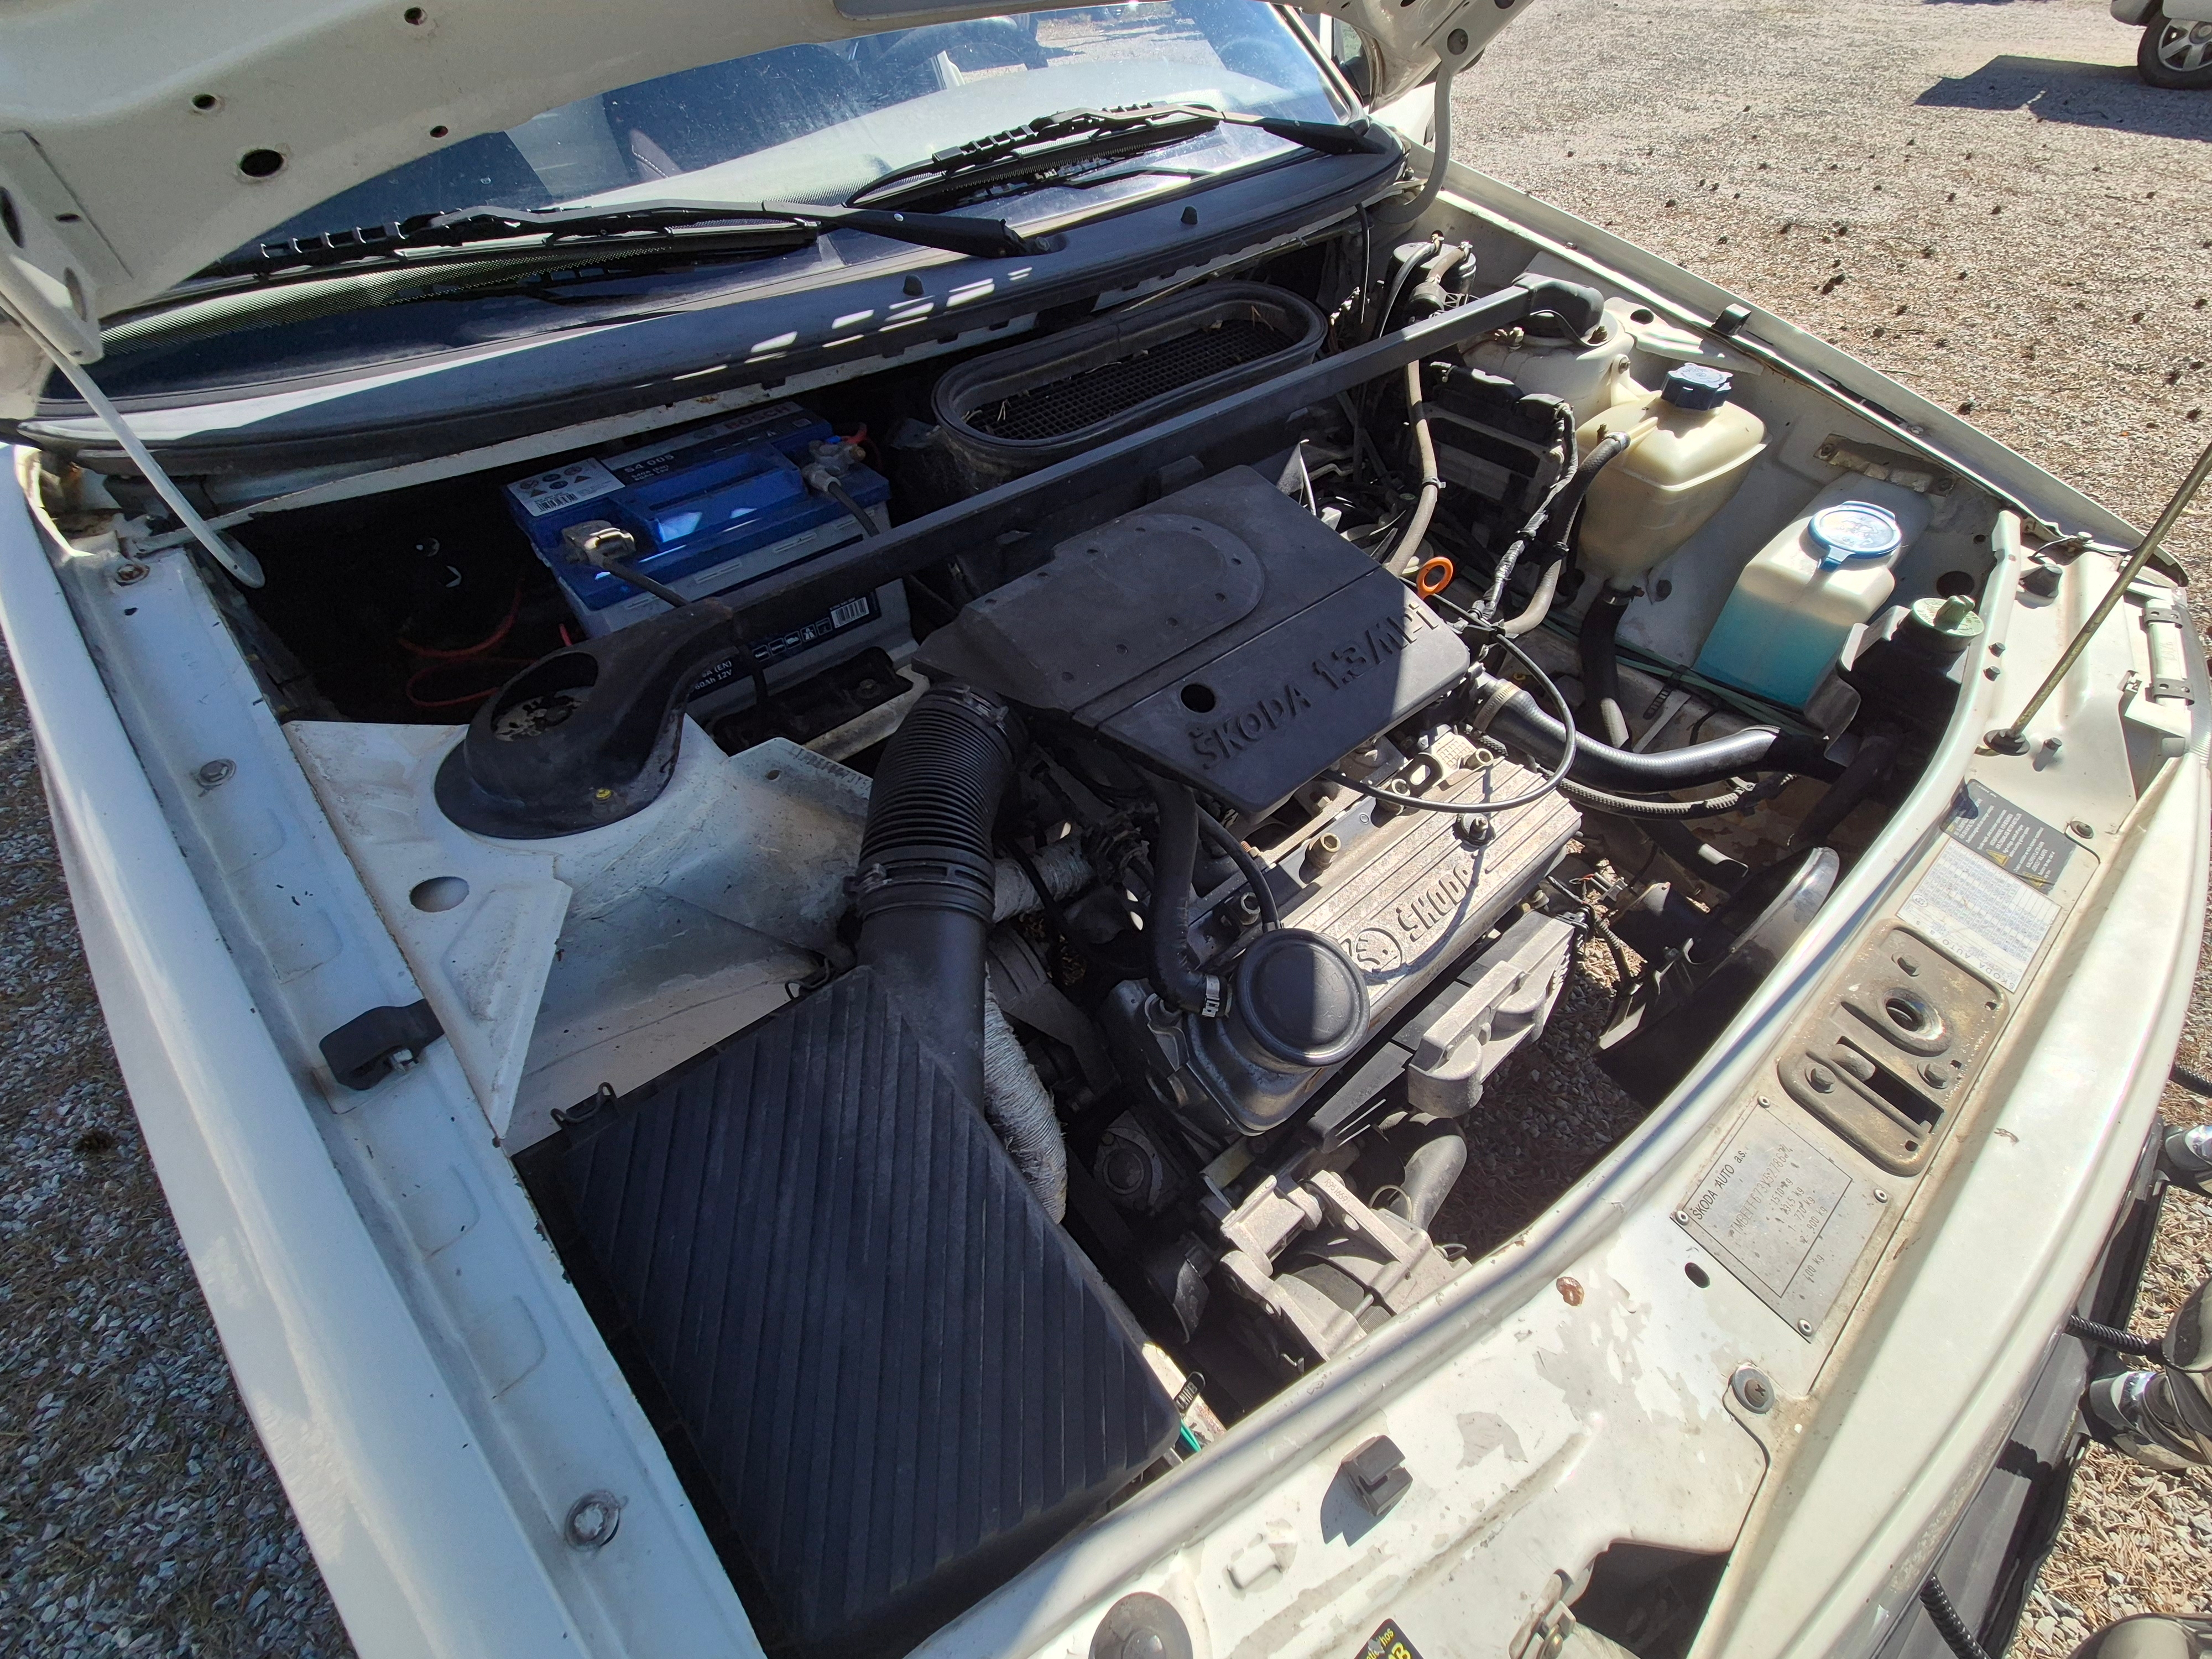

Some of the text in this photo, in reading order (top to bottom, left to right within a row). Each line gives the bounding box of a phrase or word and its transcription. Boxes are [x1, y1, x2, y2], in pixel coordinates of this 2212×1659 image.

[716, 668, 732, 680] 12V
[1188, 681, 1312, 770] ŠKODA
[1942, 938, 1971, 959] AUTO
[1689, 1149, 1747, 1220] ŠKODA AUTO a.s.
[1791, 1186, 1804, 1196] kg
[1793, 1205, 1807, 1220] 770
[1803, 1195, 1815, 1206] kg
[1806, 1215, 1820, 1230] 900
[1816, 1206, 1828, 1215] kg
[1813, 1254, 1825, 1268] kg
